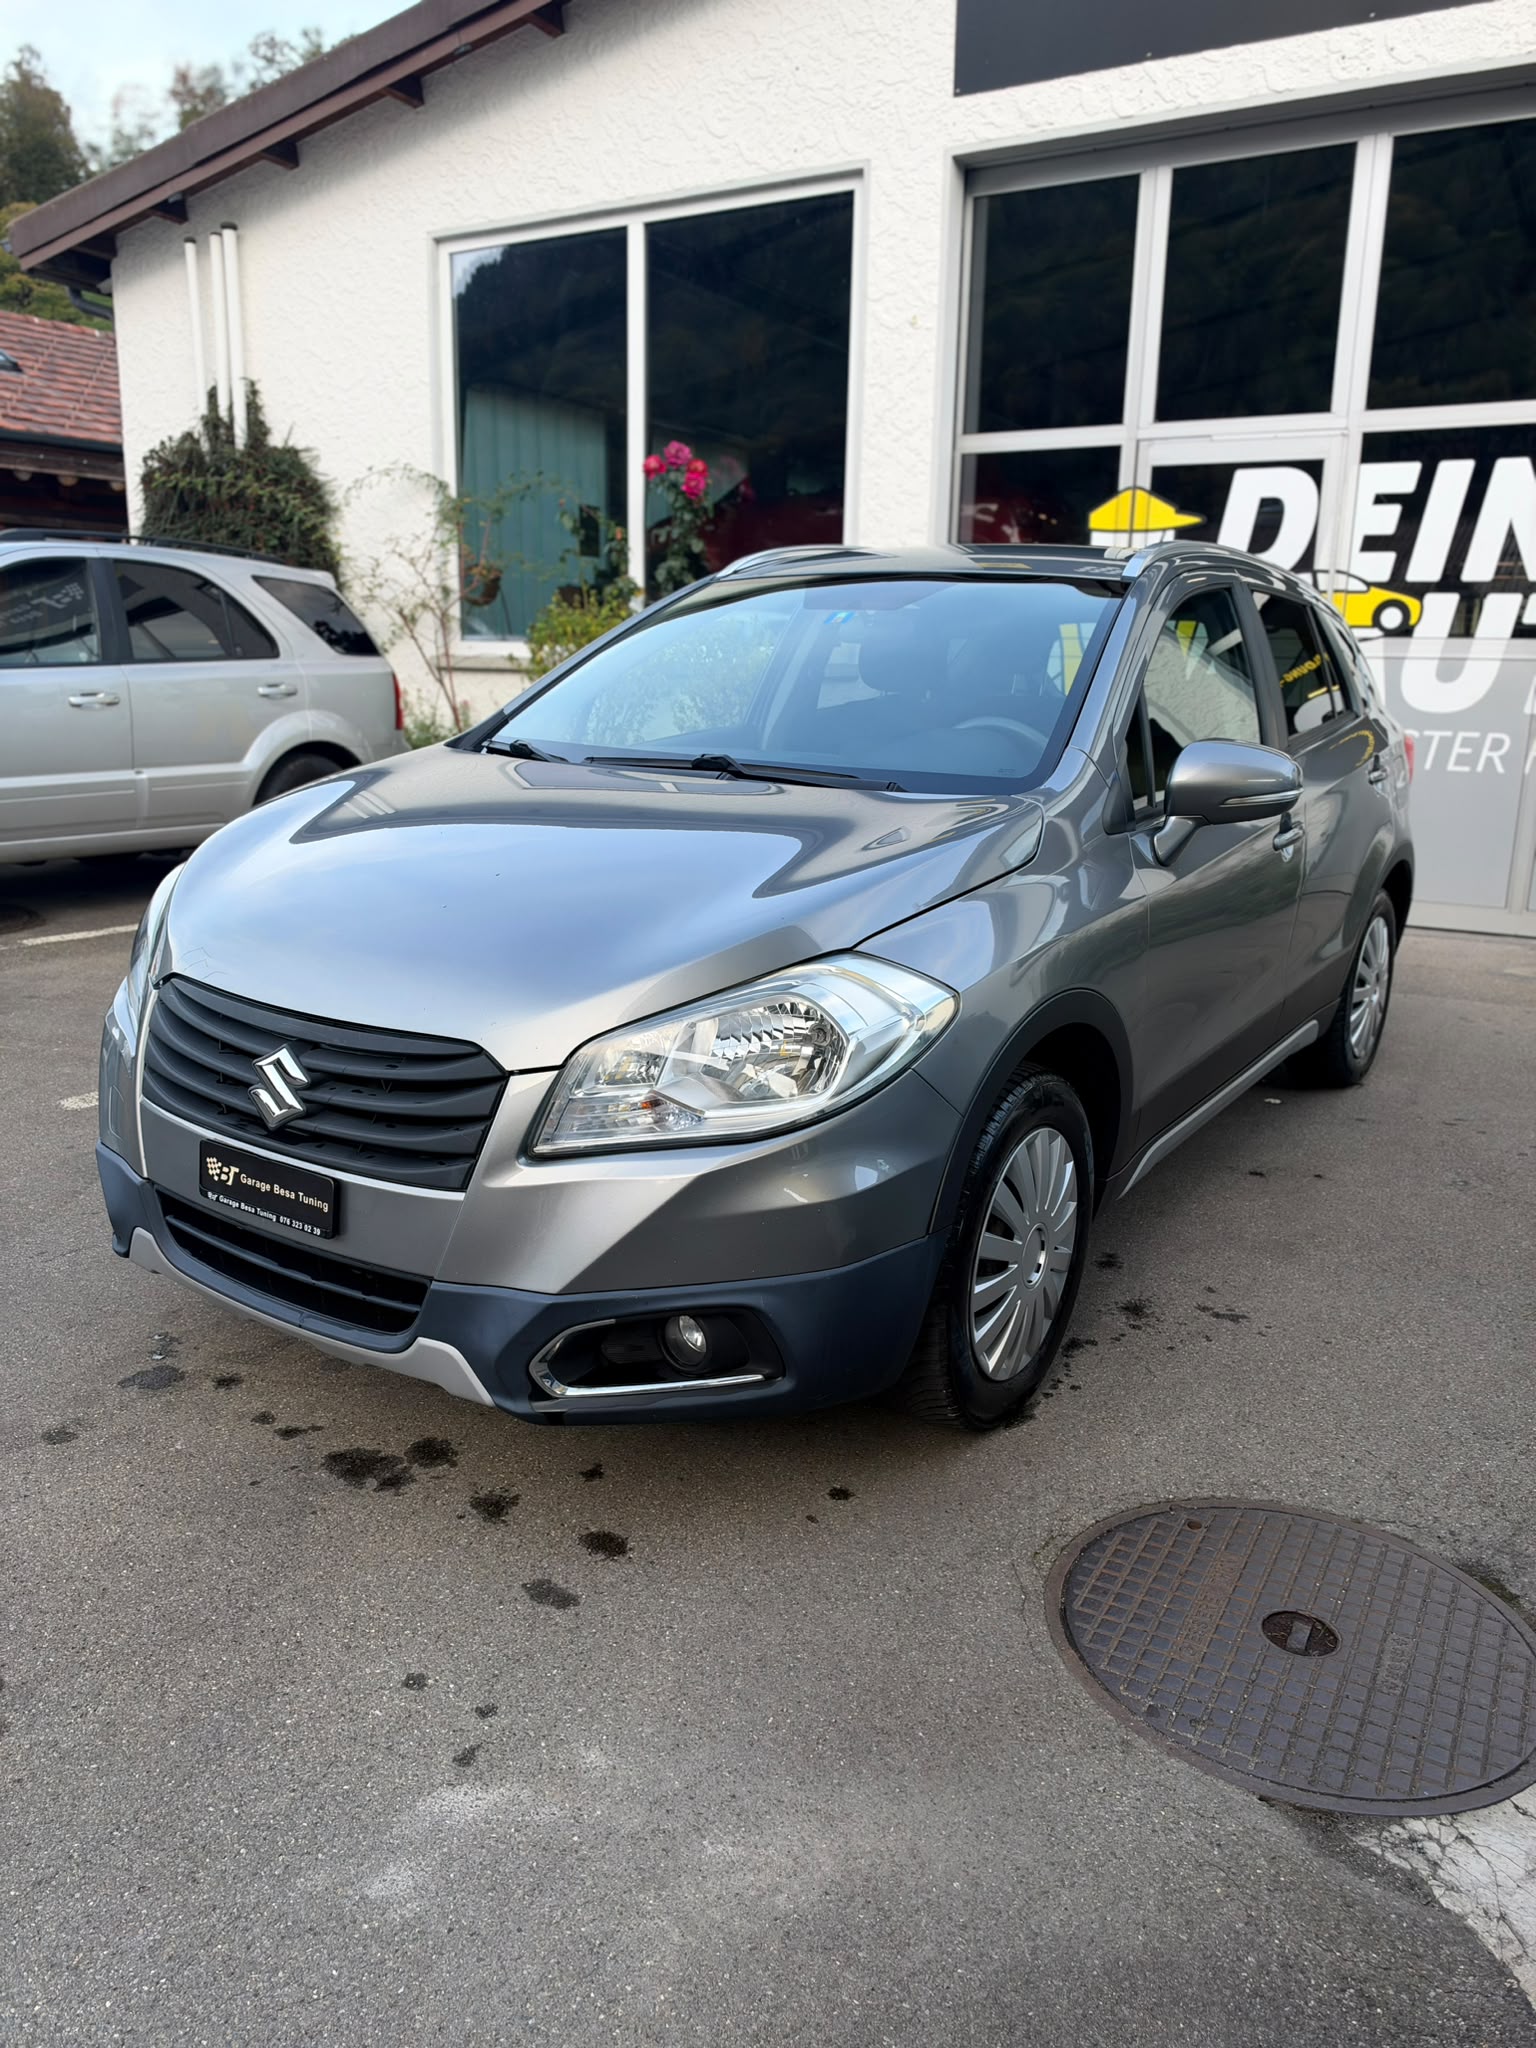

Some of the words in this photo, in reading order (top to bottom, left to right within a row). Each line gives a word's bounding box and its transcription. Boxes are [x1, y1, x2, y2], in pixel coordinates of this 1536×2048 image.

[240, 1173, 271, 1192] Garage
[273, 1184, 295, 1200] Besa
[298, 1191, 329, 1213] Tuning
[219, 1195, 239, 1208] Garage
[240, 1202, 255, 1213] Besa
[256, 1207, 277, 1222] Tuning
[280, 1215, 291, 1226] 076
[292, 1220, 303, 1230] 323
